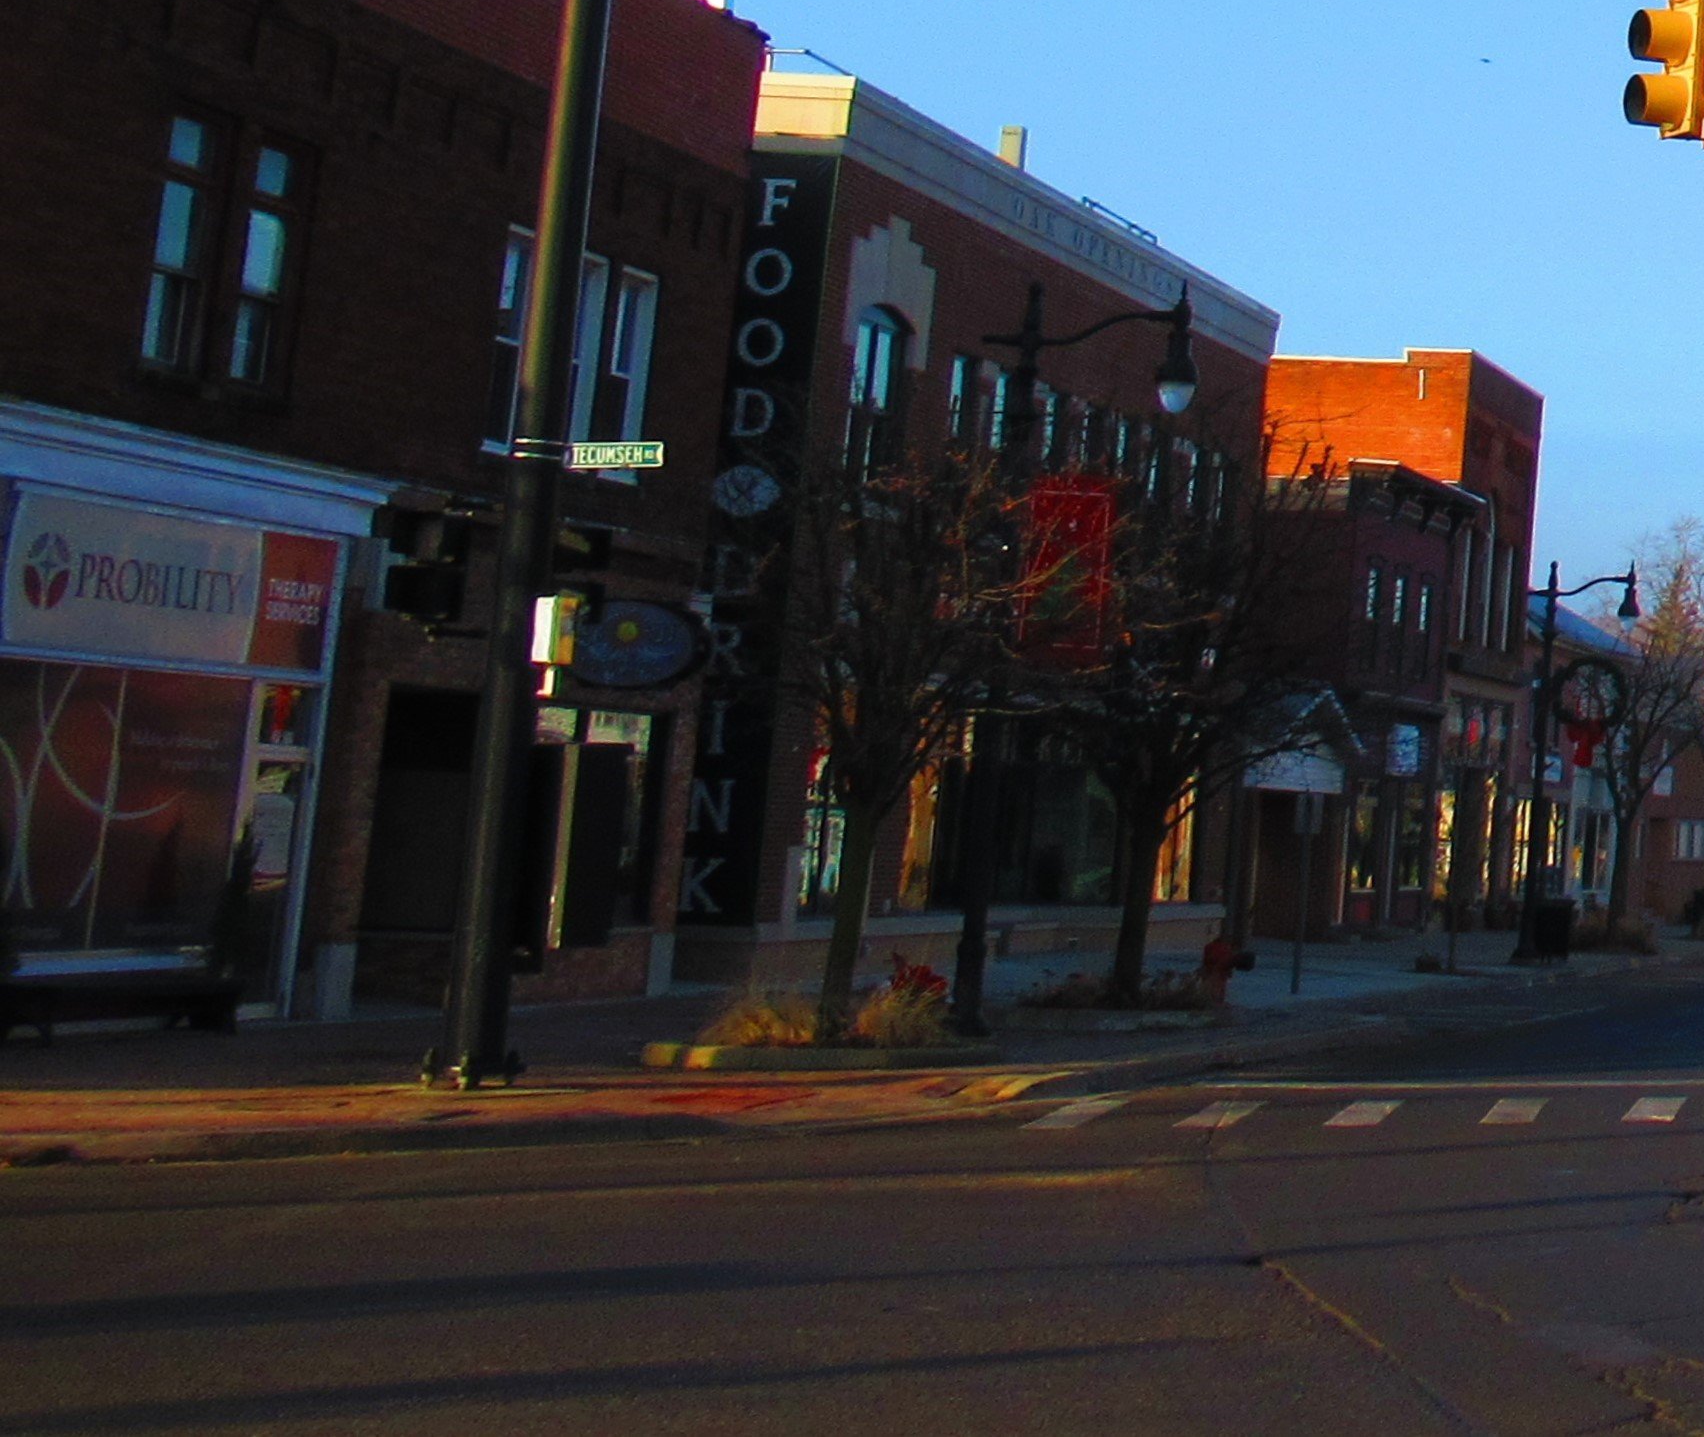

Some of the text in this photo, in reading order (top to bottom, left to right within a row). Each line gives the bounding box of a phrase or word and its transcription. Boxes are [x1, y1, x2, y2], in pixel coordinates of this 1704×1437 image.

[730, 177, 798, 437] FOOD
[573, 446, 643, 464] TECUMSEH
[75, 553, 243, 614] PROBILITY
[679, 544, 760, 913] DRINK
